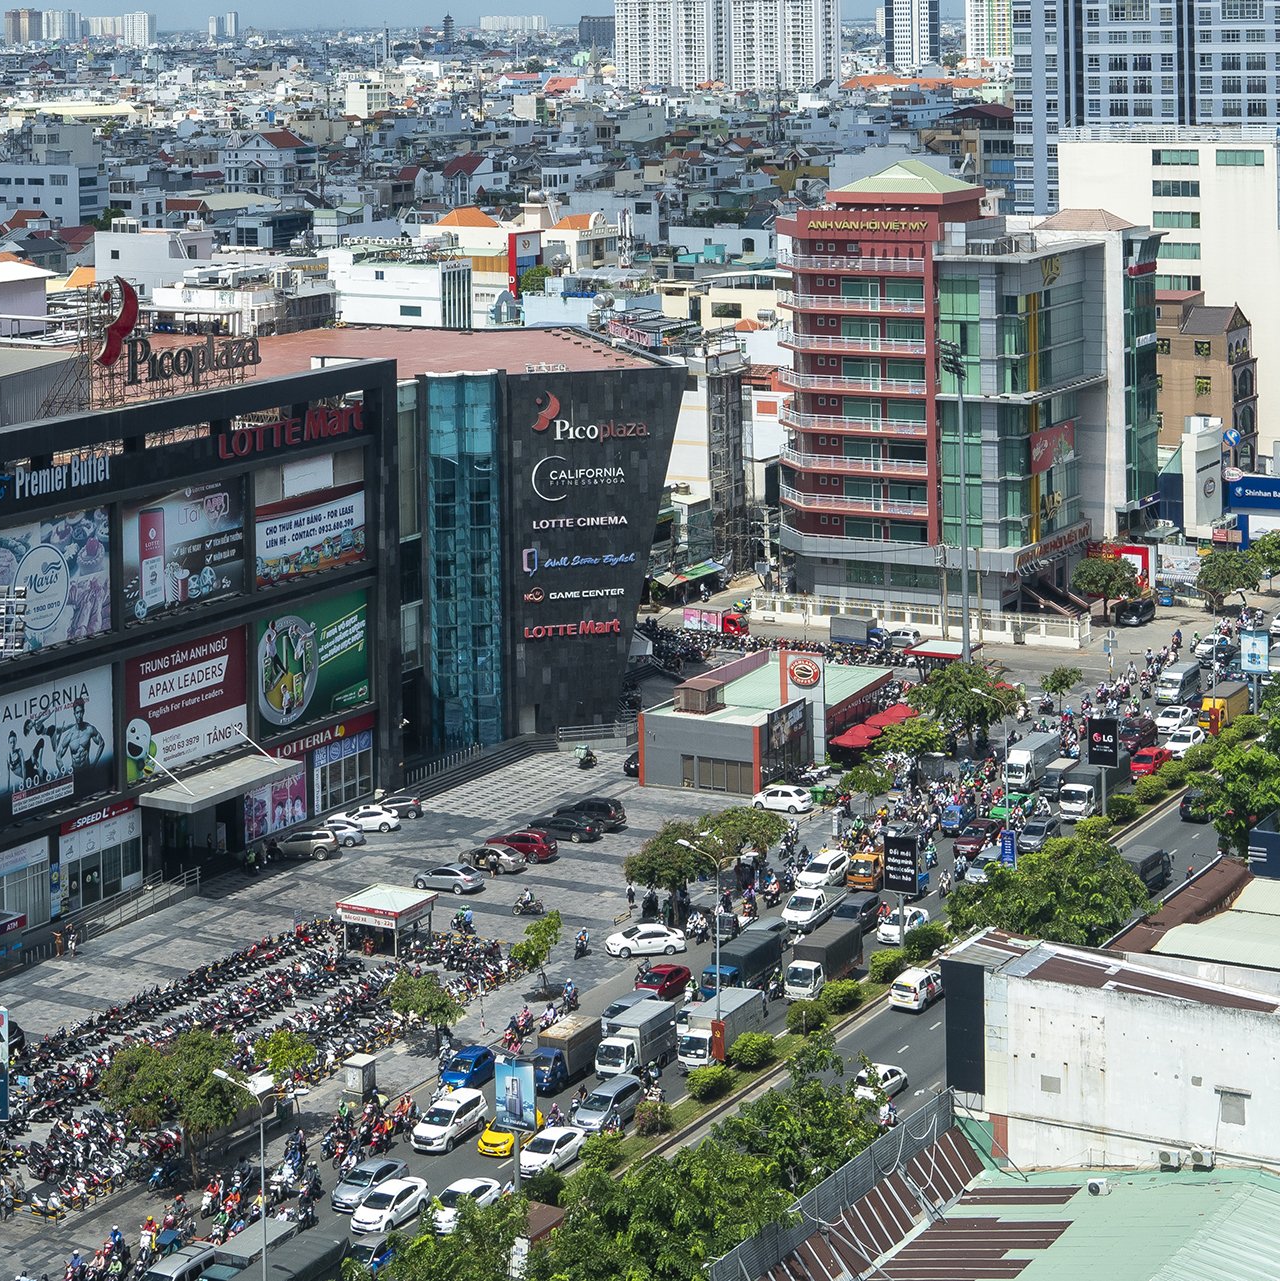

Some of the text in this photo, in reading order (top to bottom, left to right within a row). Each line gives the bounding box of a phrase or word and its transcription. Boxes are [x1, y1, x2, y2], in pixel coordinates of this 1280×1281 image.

[808, 220, 833, 229] ANH
[835, 219, 859, 229] VĂN
[861, 218, 880, 232] HỘI
[881, 219, 907, 232] VIỆT
[218, 400, 364, 459] LOTTE Mart
[15, 454, 110, 500] Premier Buffet
[549, 467, 625, 481] CALIFORNIA
[1244, 488, 1272, 498] Shinhan
[265, 525, 278, 536] CHO
[327, 509, 338, 520] FOR
[338, 504, 354, 517] LEASE
[532, 515, 628, 530] LOTTE CINEMA
[543, 556, 571, 568] Wall
[549, 588, 625, 600] GAME CENTER
[524, 618, 620, 639] LOTTE Mart
[139, 636, 228, 675] TRUNG TÂM ANH NGỮ
[148, 662, 224, 699] APAX LEADERS
[148, 687, 225, 719] English For Future Leaders
[206, 725, 232, 746] TẦNG
[276, 729, 332, 759] LOTTERIA
[1102, 734, 1114, 743] LG
[76, 811, 102, 828] SPEED
[6, 920, 19, 932] ATM
